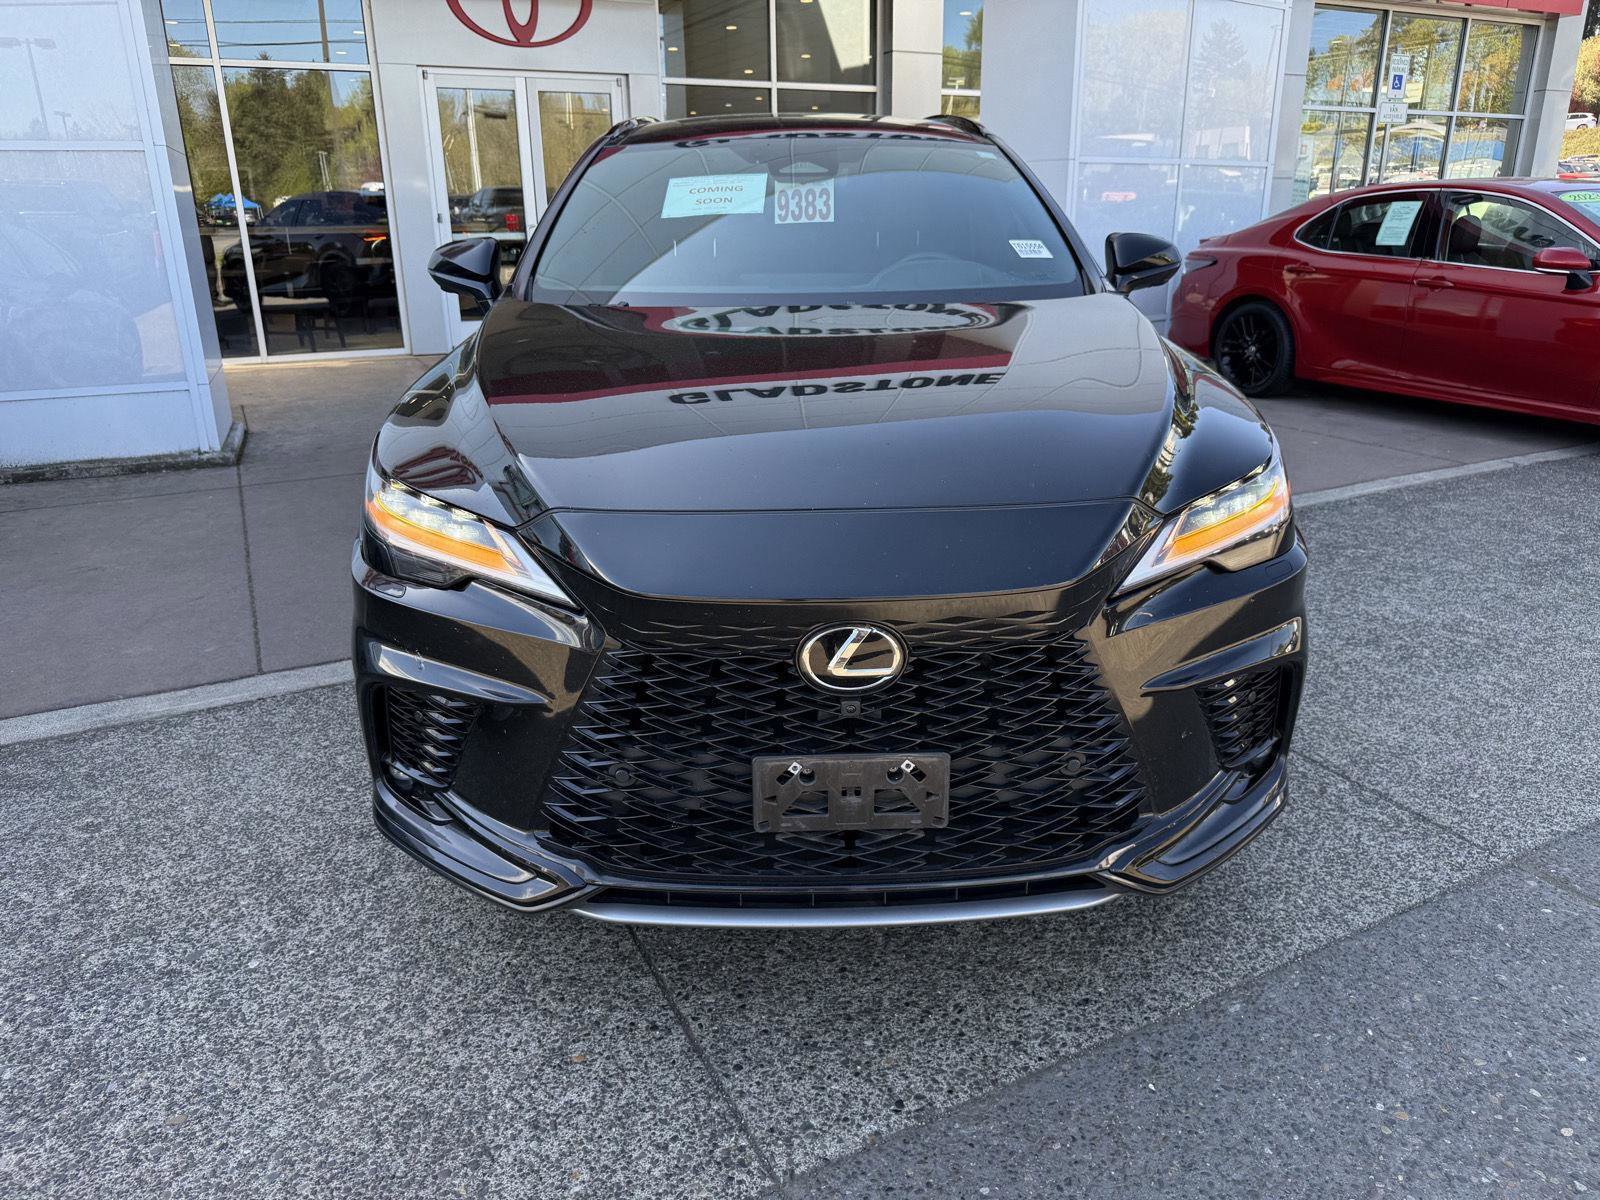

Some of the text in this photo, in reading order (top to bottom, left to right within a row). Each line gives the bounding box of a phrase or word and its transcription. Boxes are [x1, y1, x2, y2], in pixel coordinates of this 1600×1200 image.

[688, 185, 744, 195] COMING
[695, 196, 733, 206] SOON
[777, 187, 832, 222] 9383
